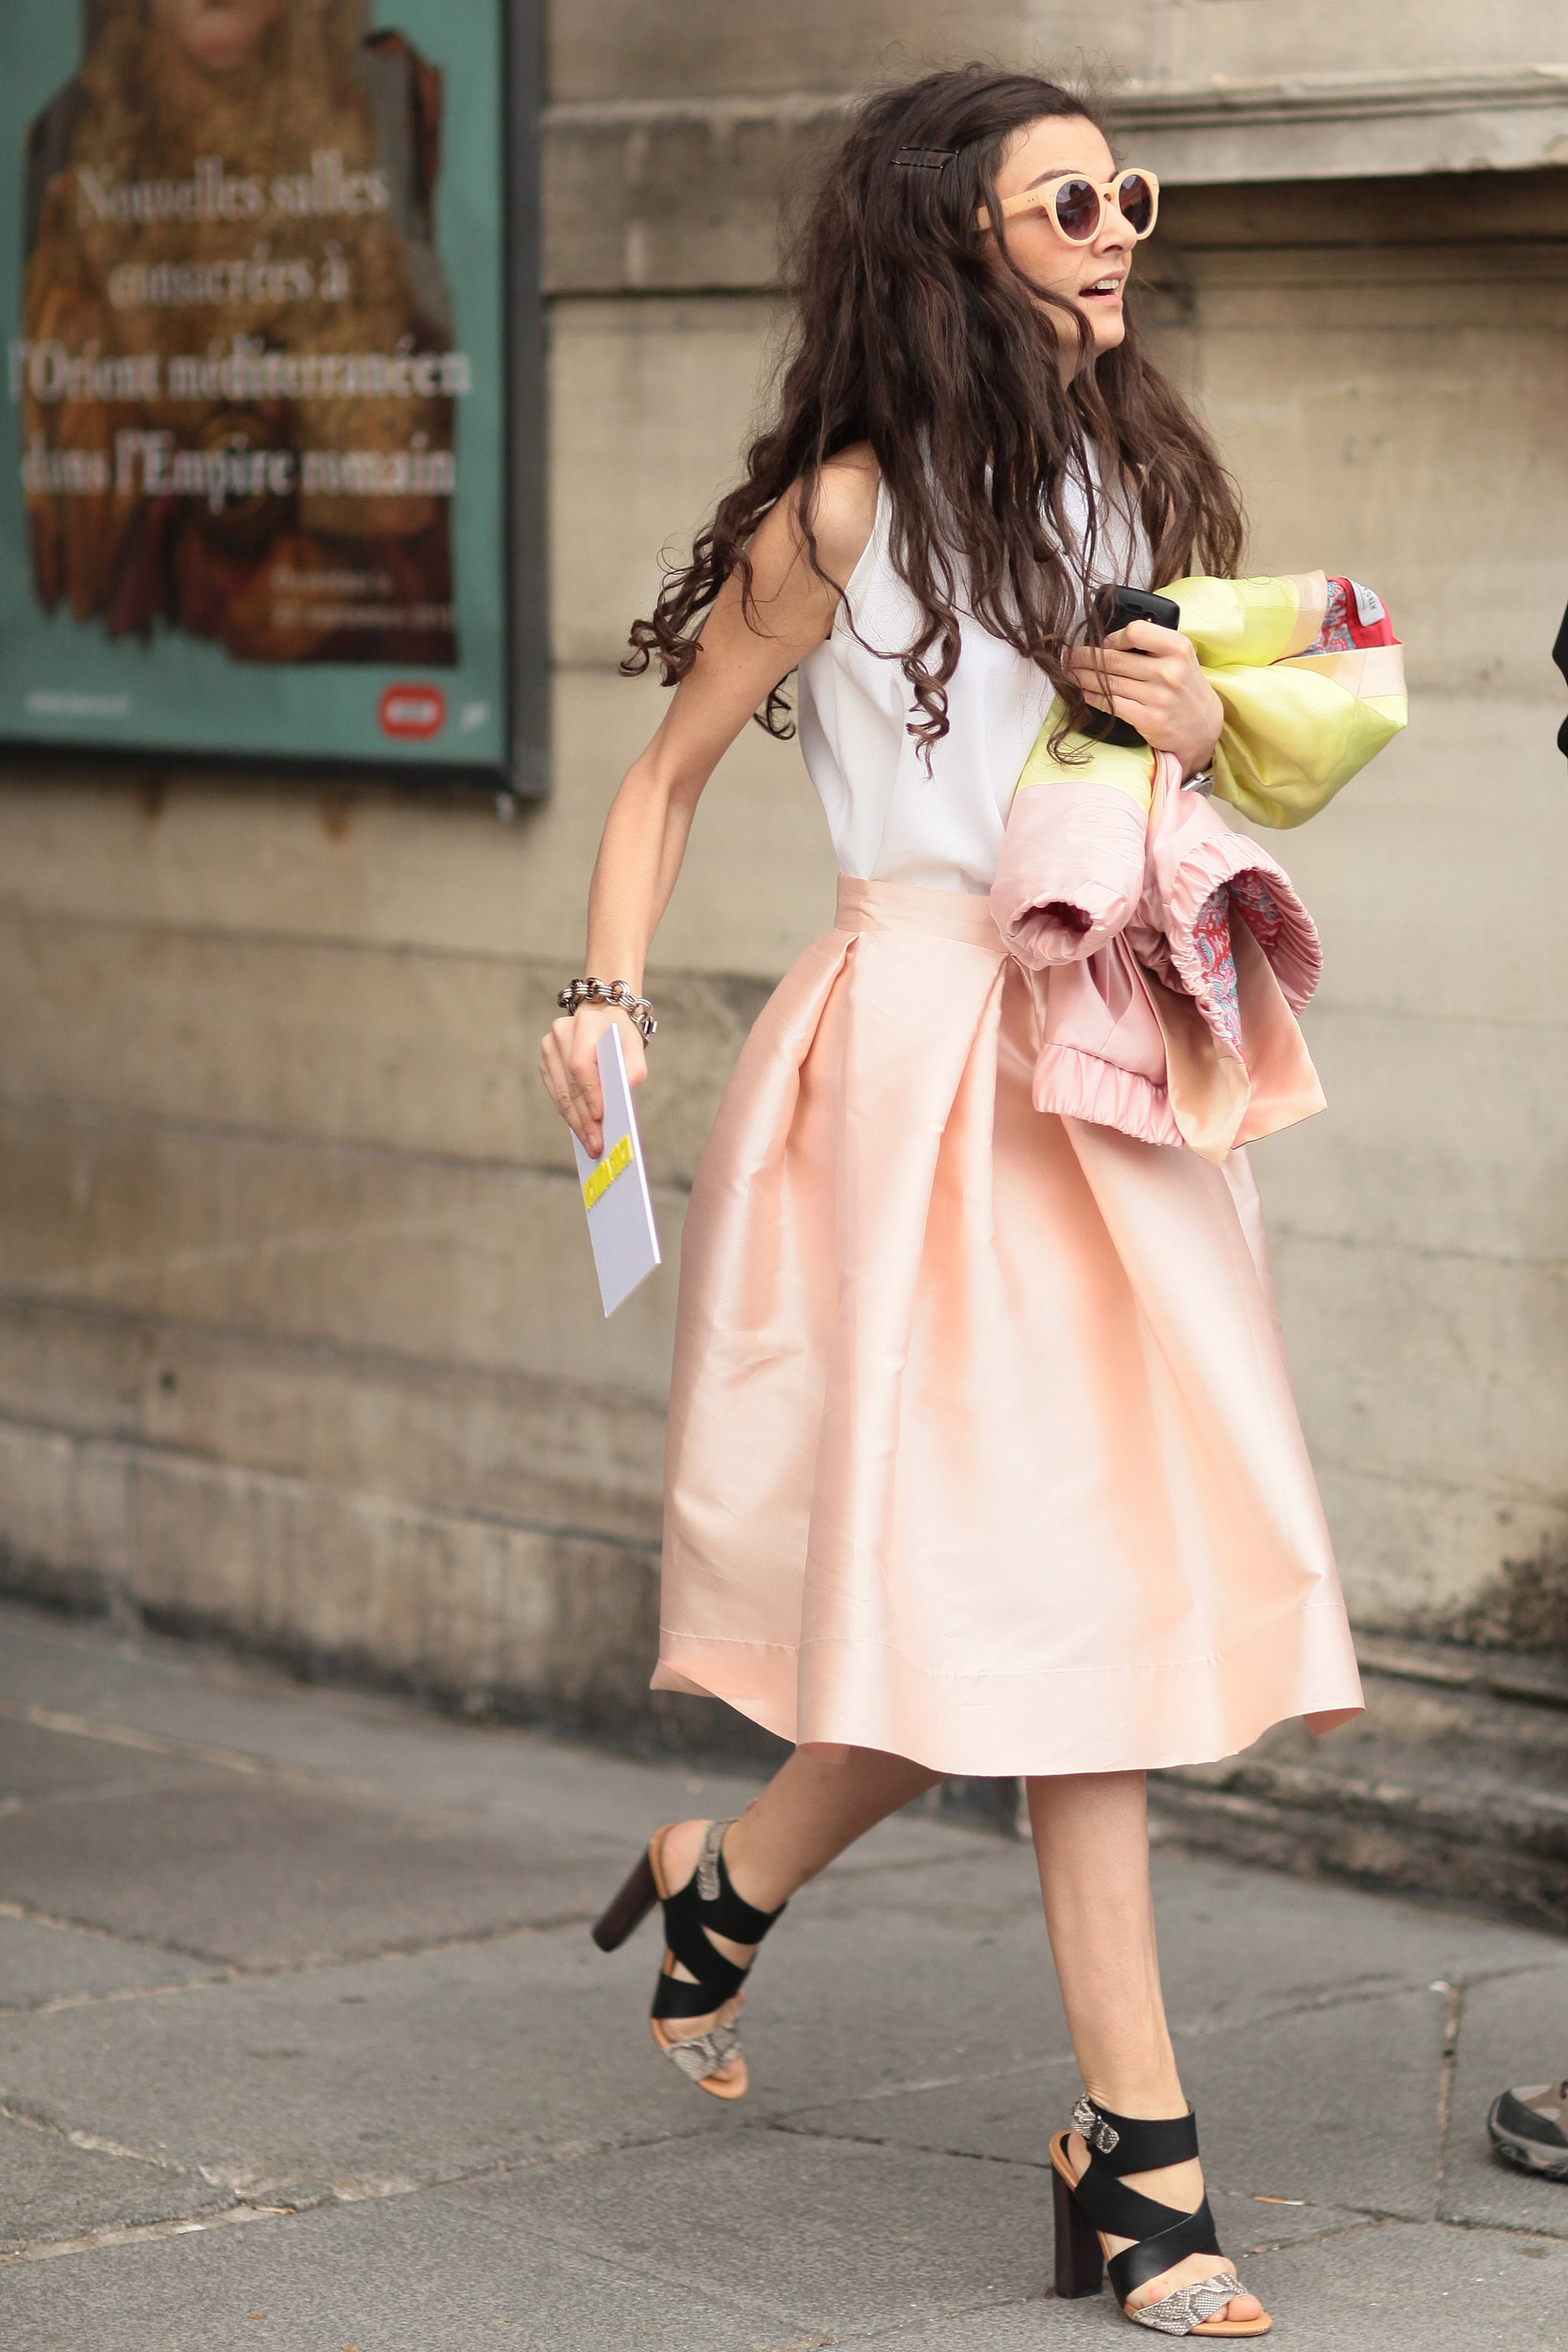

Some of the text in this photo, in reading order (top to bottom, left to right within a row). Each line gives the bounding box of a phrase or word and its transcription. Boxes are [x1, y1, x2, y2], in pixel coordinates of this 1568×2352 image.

[77, 150, 389, 222] Nouvelles salles
[168, 332, 472, 399] méditerranéen
[114, 430, 294, 514] l'Empire
[301, 432, 456, 496] romain
